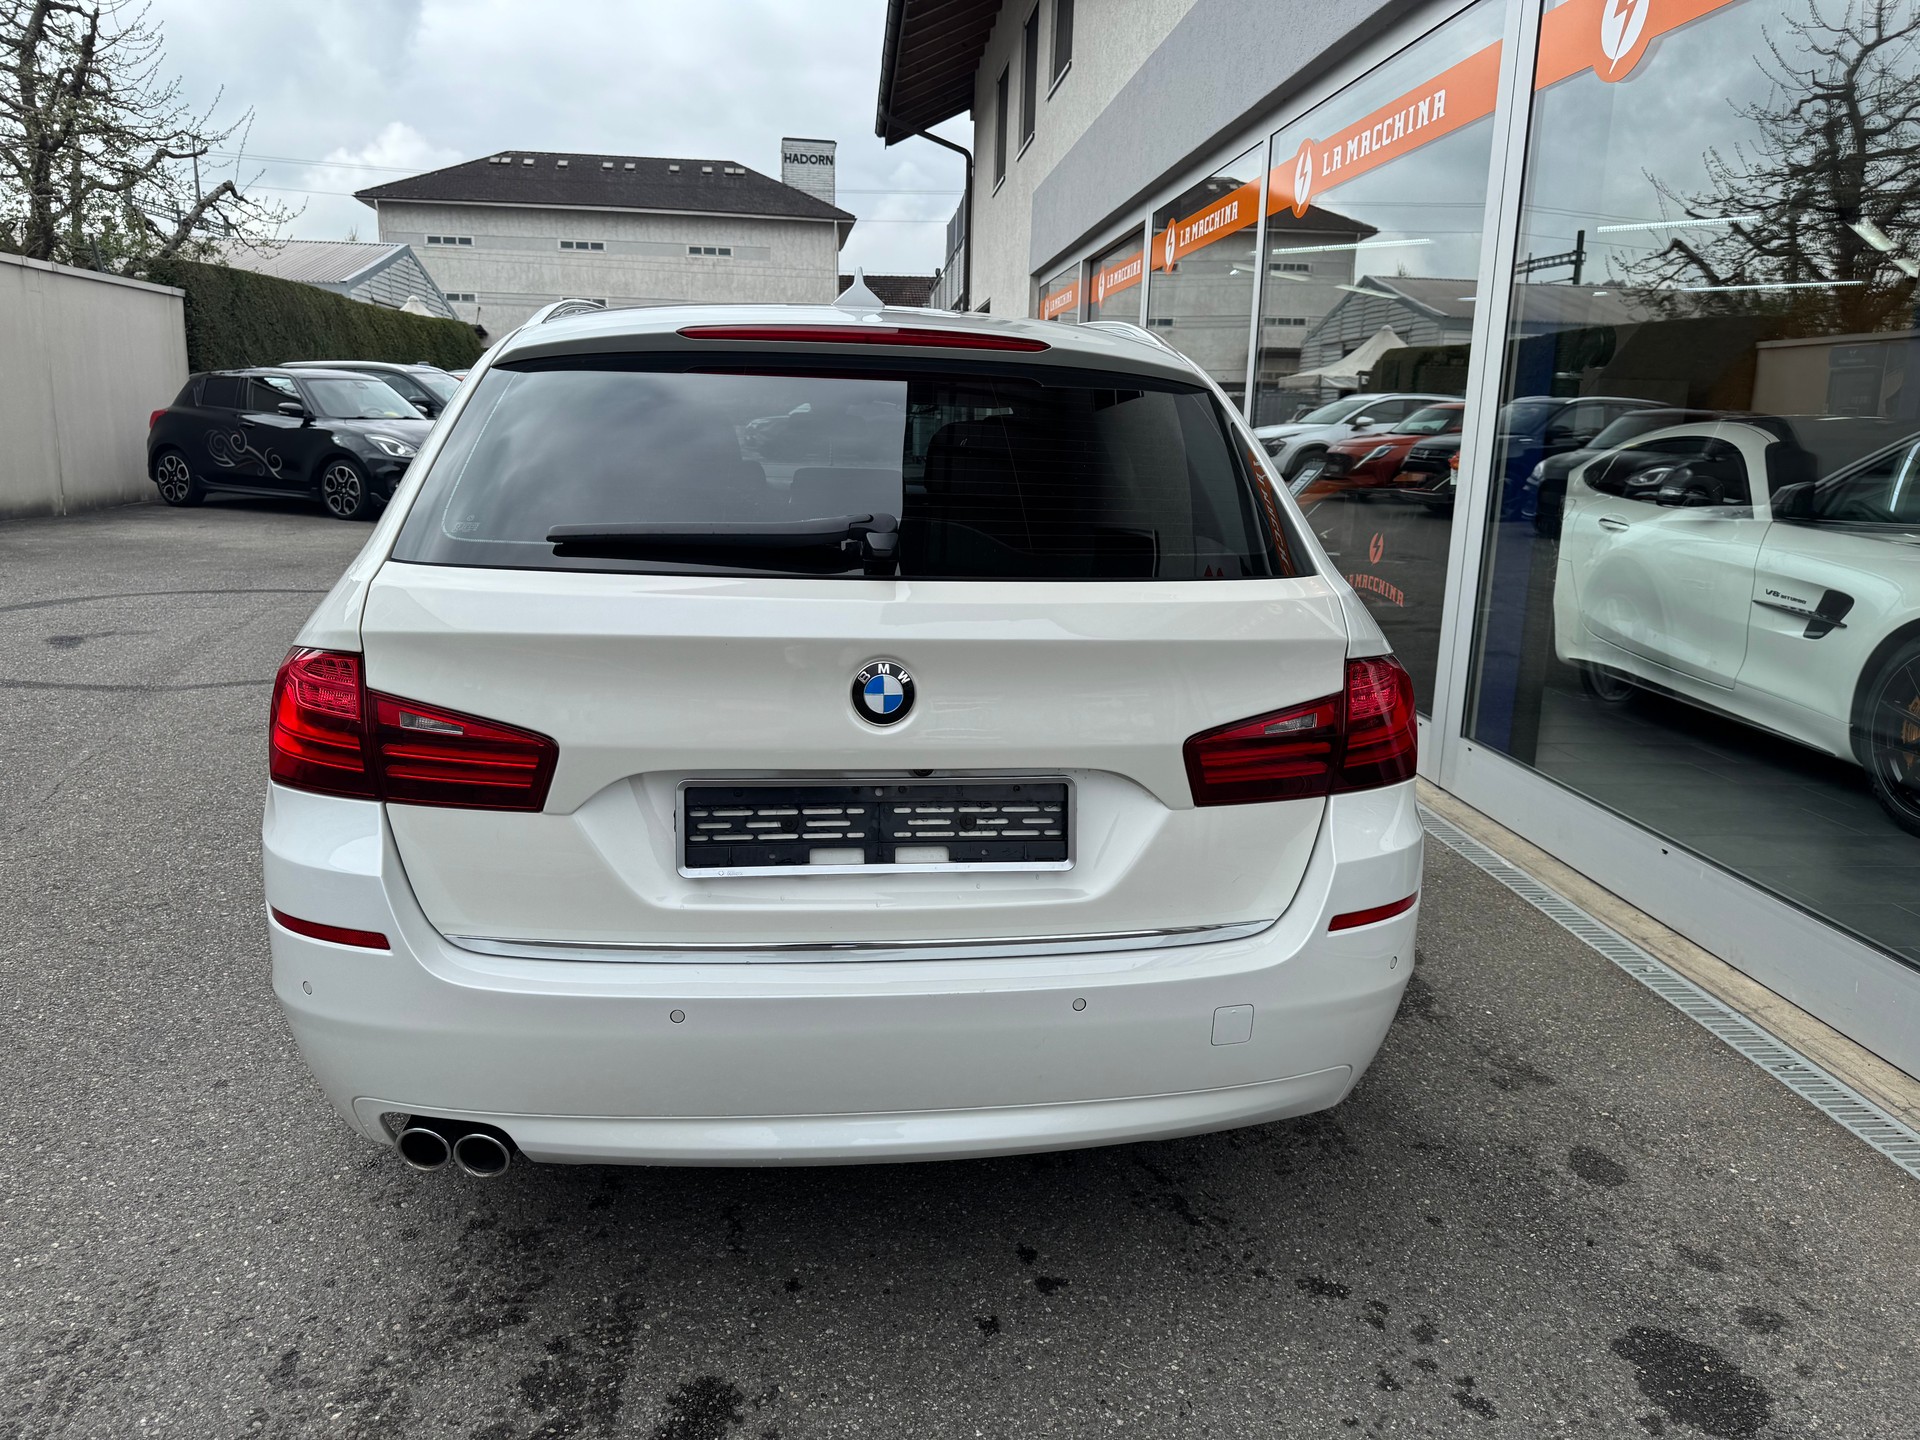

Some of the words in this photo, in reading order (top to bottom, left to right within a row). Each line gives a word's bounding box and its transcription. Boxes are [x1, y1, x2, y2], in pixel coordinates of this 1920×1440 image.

[1322, 145, 1343, 177] LA
[1345, 89, 1446, 165] MACCHINA
[783, 152, 834, 166] HADORN
[1179, 226, 1191, 248] LA
[1191, 200, 1239, 242] MACCHINA
[1355, 573, 1404, 608] MACCHINA
[1765, 588, 1780, 597] V8
[857, 663, 911, 685] BMW
